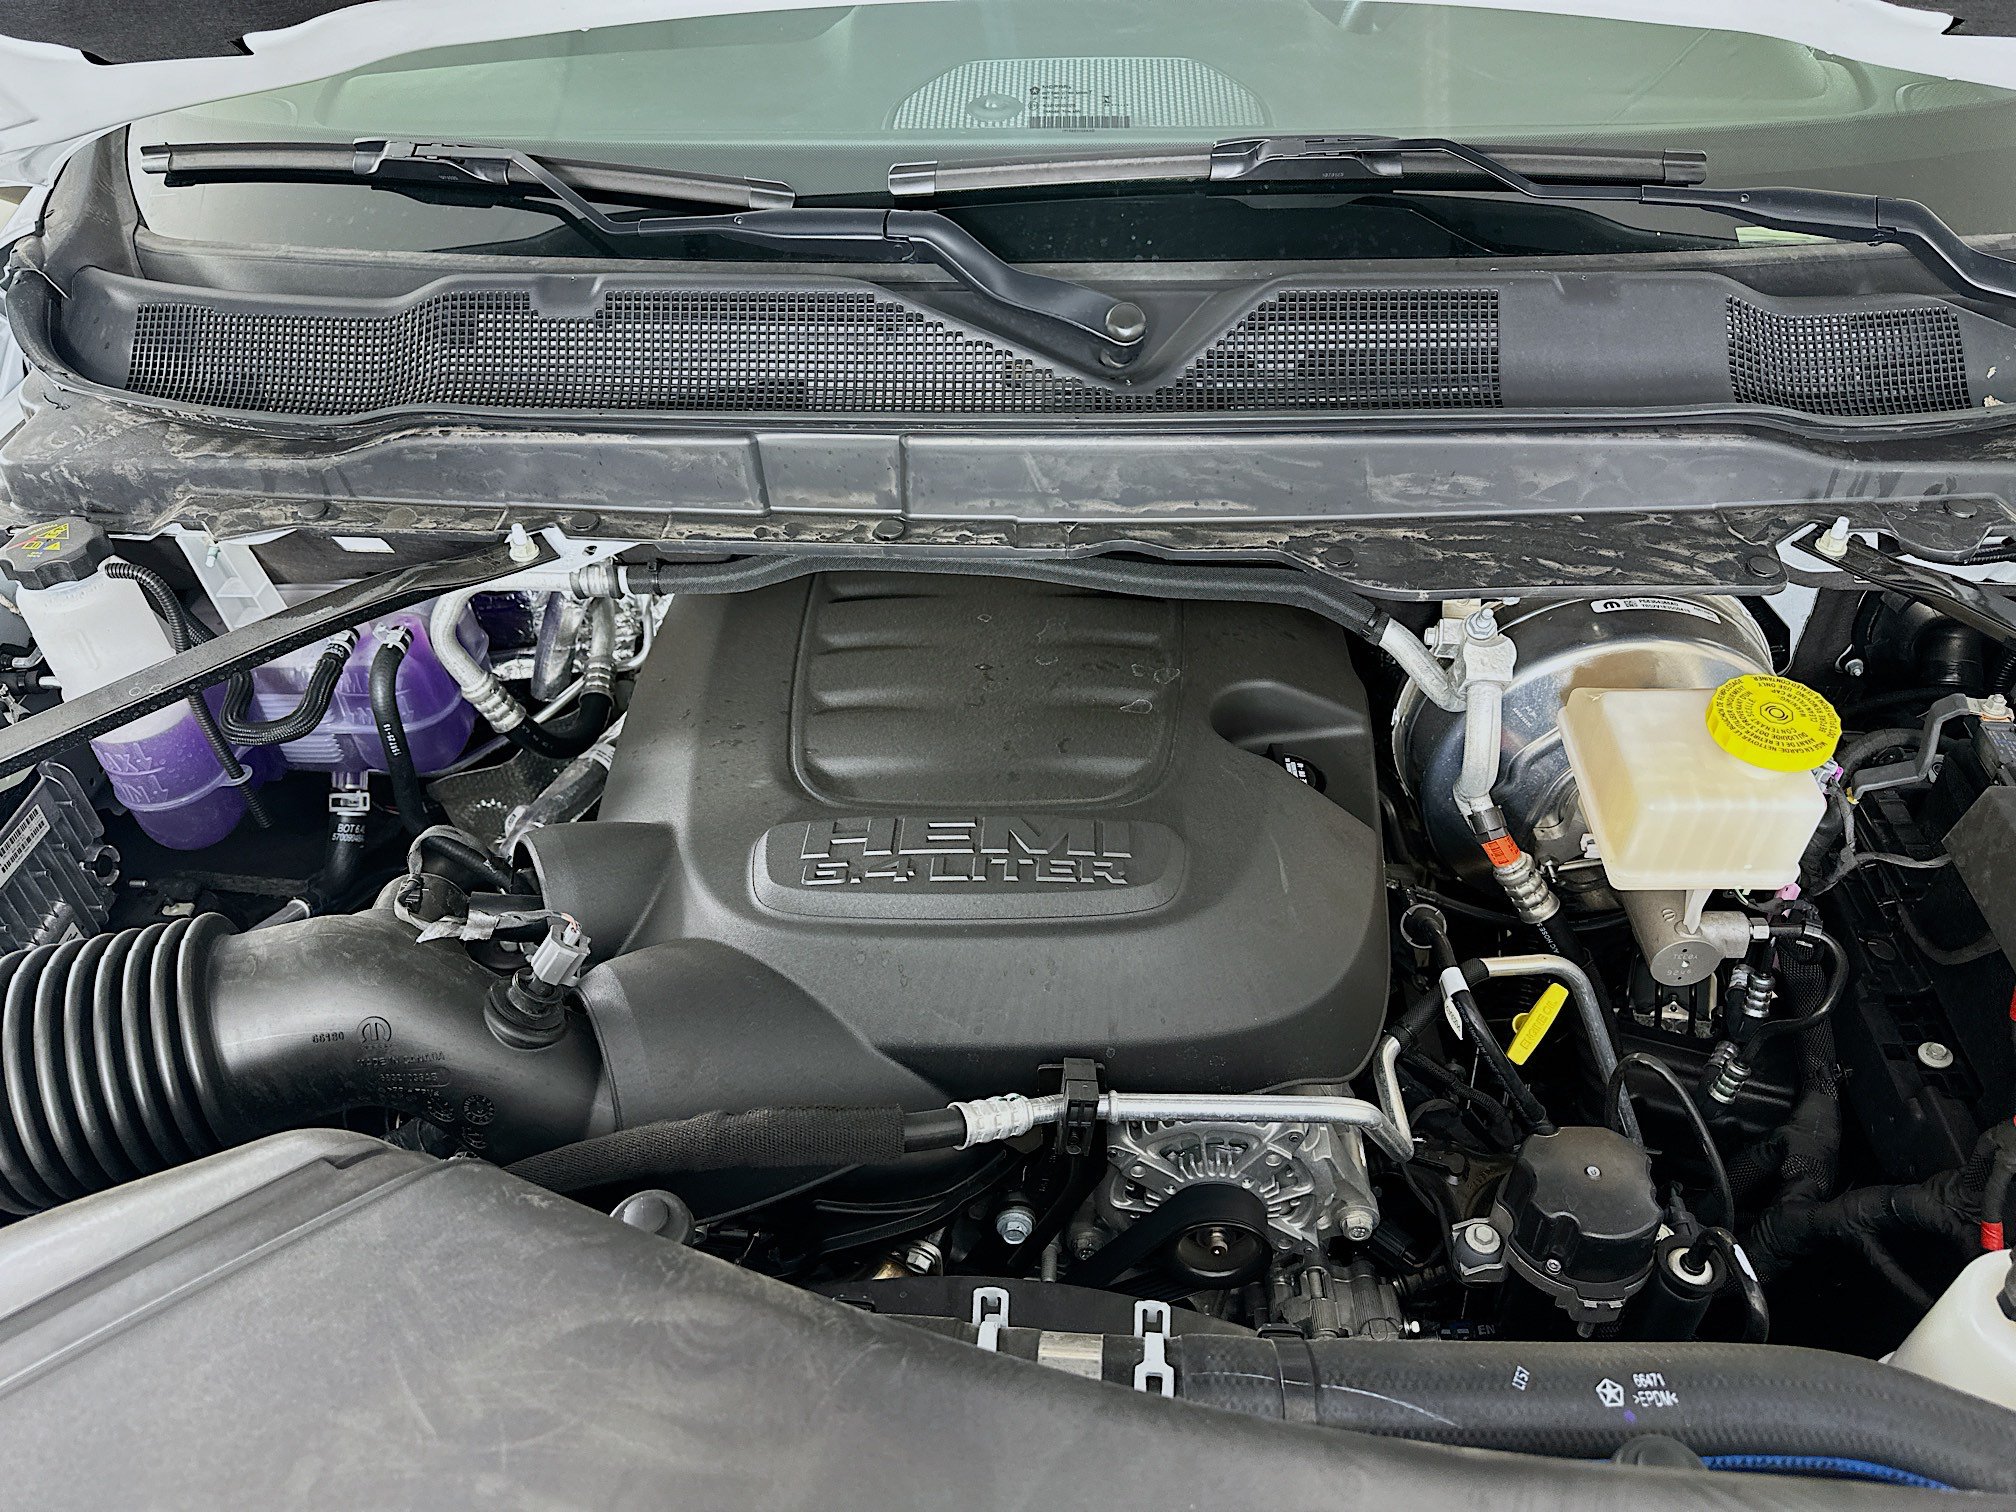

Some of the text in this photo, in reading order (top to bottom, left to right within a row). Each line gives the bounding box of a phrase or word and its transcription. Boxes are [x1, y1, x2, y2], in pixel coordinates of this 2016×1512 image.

[1750, 718, 1797, 734] CONTENANT
[1755, 728, 1769, 737] DOT
[337, 823, 355, 833] BOT
[800, 816, 1132, 859] HEMI
[801, 856, 1128, 886] 6.4 LITER
[1539, 926, 1553, 945] HOSE
[1519, 998, 1557, 1051] ENGINE OIL
[1632, 1372, 1666, 1389] 66471
